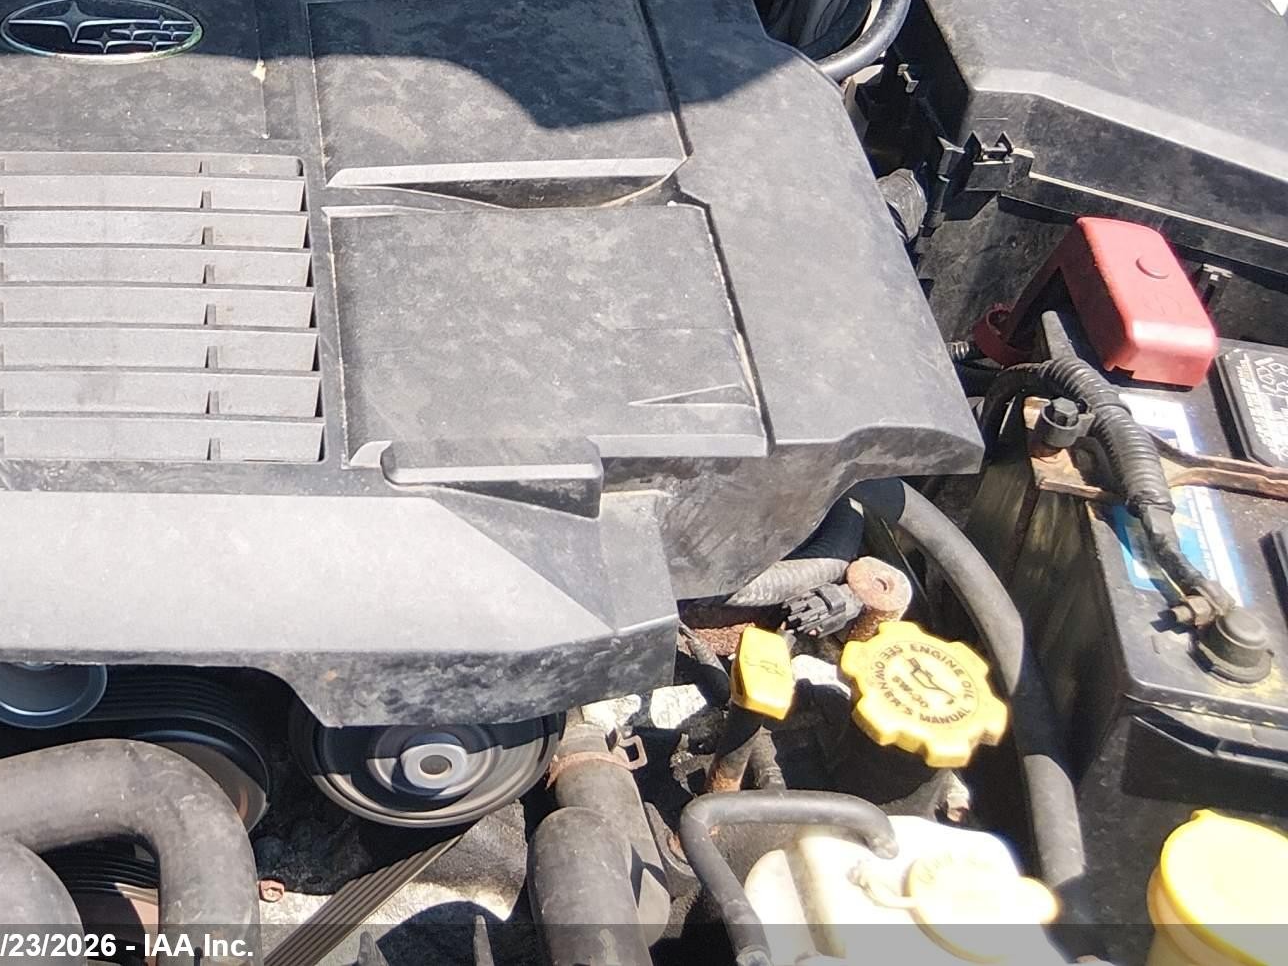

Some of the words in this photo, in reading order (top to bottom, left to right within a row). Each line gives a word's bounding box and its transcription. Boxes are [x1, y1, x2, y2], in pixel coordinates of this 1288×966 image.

[879, 643, 904, 661] SEE
[874, 661, 914, 716] OWNER'S
[909, 643, 965, 678] ENGINE
[961, 680, 975, 700] OIL
[919, 707, 972, 724] MANUAL
